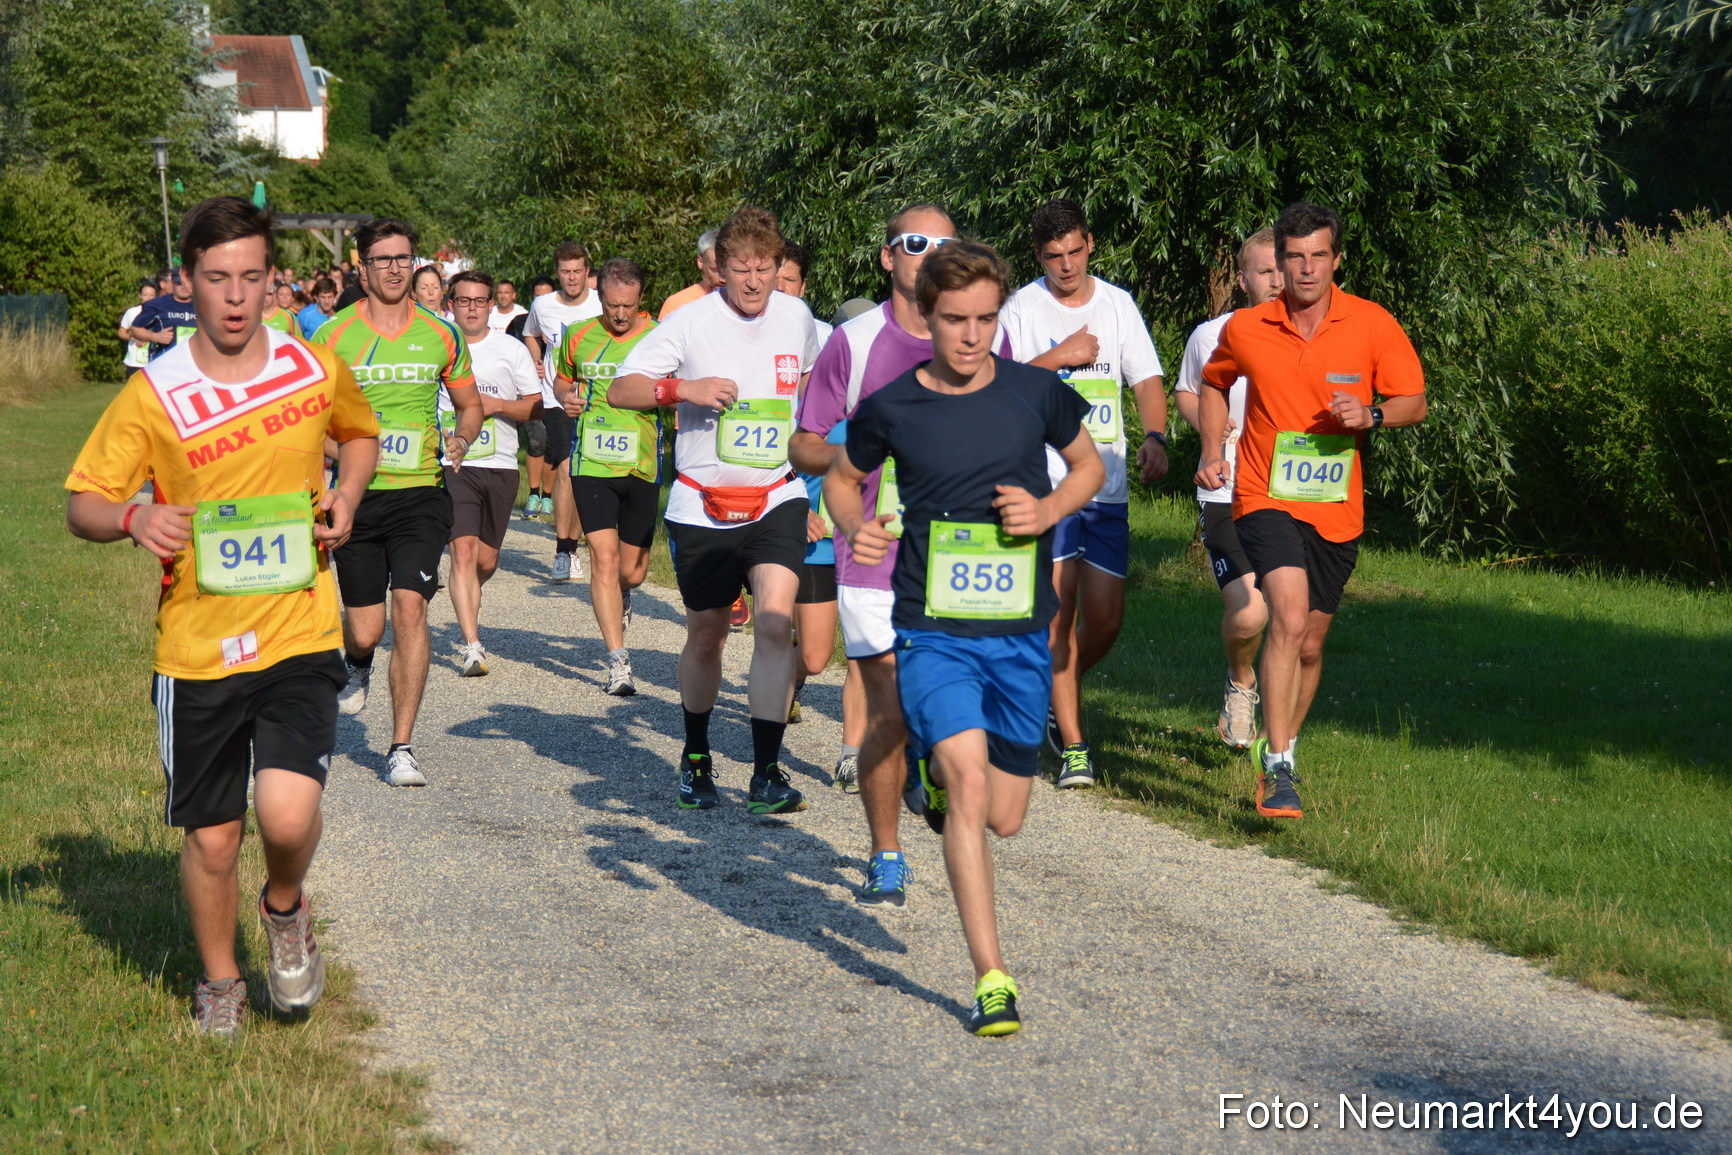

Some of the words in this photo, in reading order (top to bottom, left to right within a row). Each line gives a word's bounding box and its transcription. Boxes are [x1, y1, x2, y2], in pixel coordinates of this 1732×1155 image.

[350, 363, 439, 387] BOCK
[1083, 404, 1112, 425] 70
[186, 425, 257, 470] MAX
[261, 392, 332, 436] BÖGL
[594, 433, 629, 452] 145
[734, 425, 779, 449] 212
[381, 434, 409, 455] 40
[1281, 459, 1344, 484] 1040
[219, 533, 287, 570] 941
[949, 562, 1014, 592] 858
[1214, 558, 1229, 578] 31
